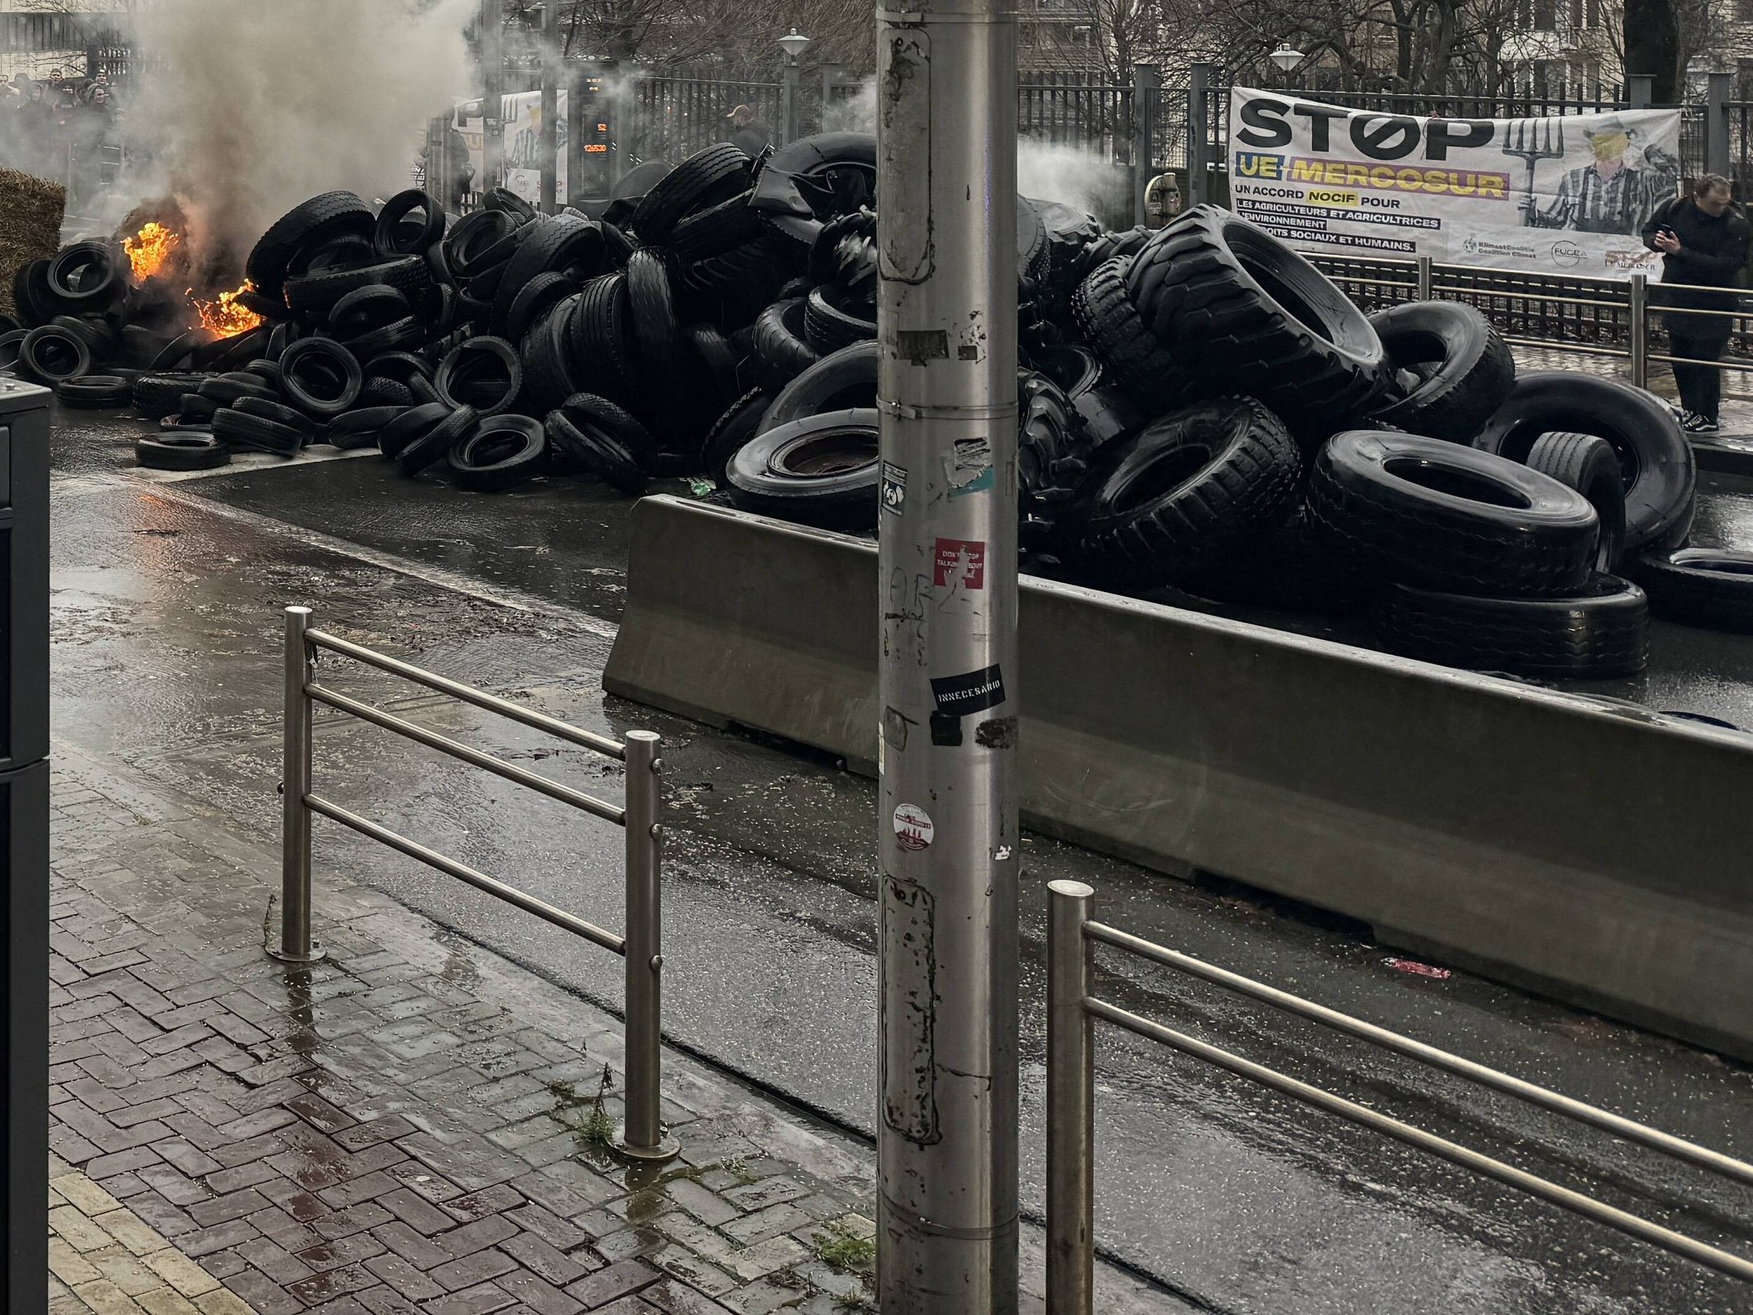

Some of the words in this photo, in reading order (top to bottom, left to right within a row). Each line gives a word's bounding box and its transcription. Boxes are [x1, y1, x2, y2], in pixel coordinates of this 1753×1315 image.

[1235, 184, 1251, 194] UN
[1252, 186, 1304, 199] ACCORD
[1308, 191, 1356, 203] NOCIF
[1361, 197, 1401, 209] POUR
[1237, 199, 1253, 209] LES
[1254, 202, 1327, 217] AGRICULTEURS
[1329, 210, 1345, 218] ET
[1346, 211, 1439, 228] AGRICULTRICES
[1290, 231, 1337, 244] SOCIAUX
[1339, 236, 1353, 244] ET
[938, 680, 1001, 703] INNECESARIO
